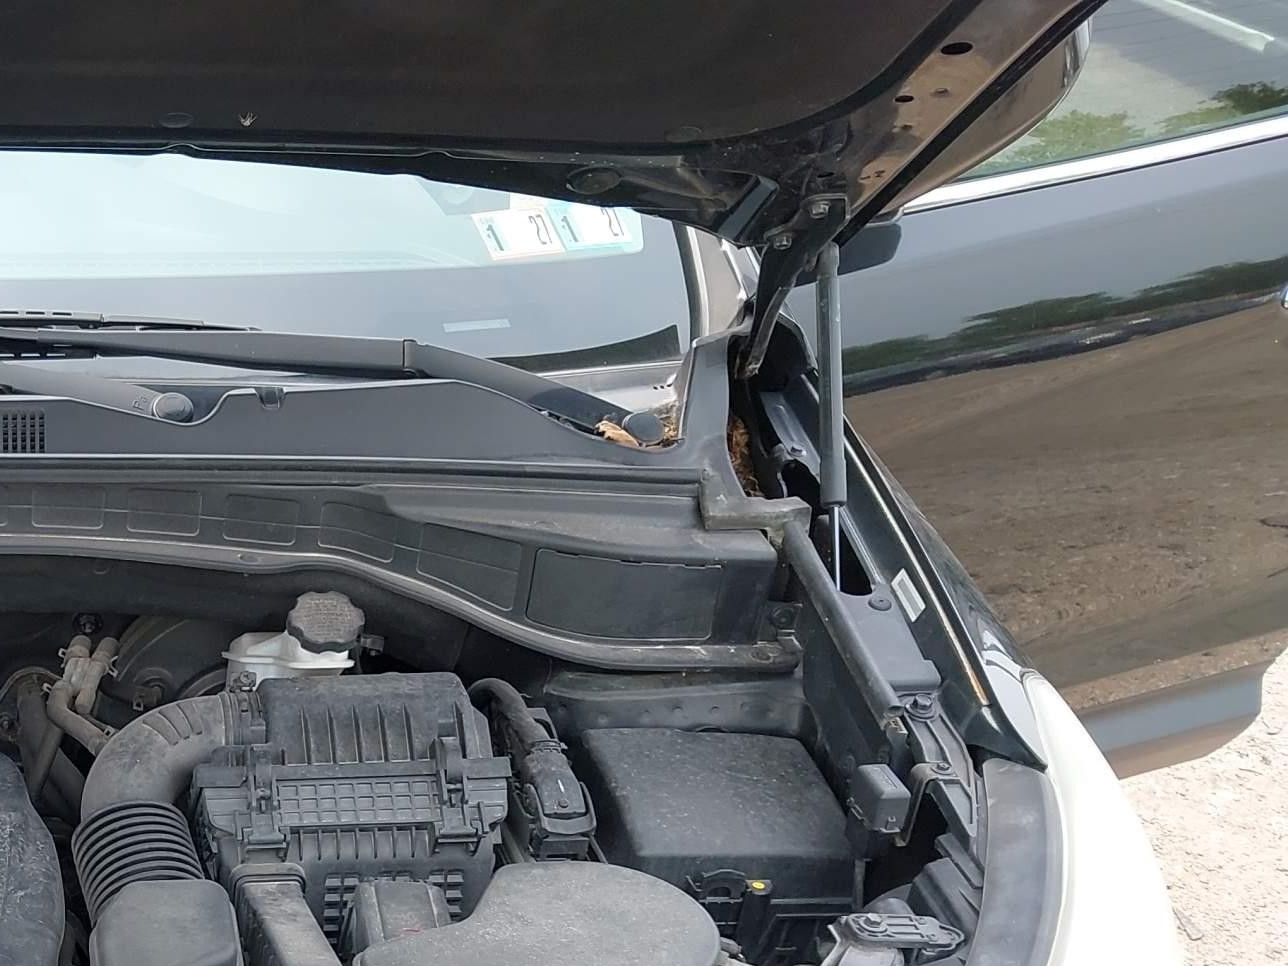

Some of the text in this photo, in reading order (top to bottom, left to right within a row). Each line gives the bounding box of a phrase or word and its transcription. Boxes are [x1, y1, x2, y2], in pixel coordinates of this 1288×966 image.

[486, 224, 504, 251] 1
[528, 214, 553, 245] 27
[561, 215, 579, 243] 1
